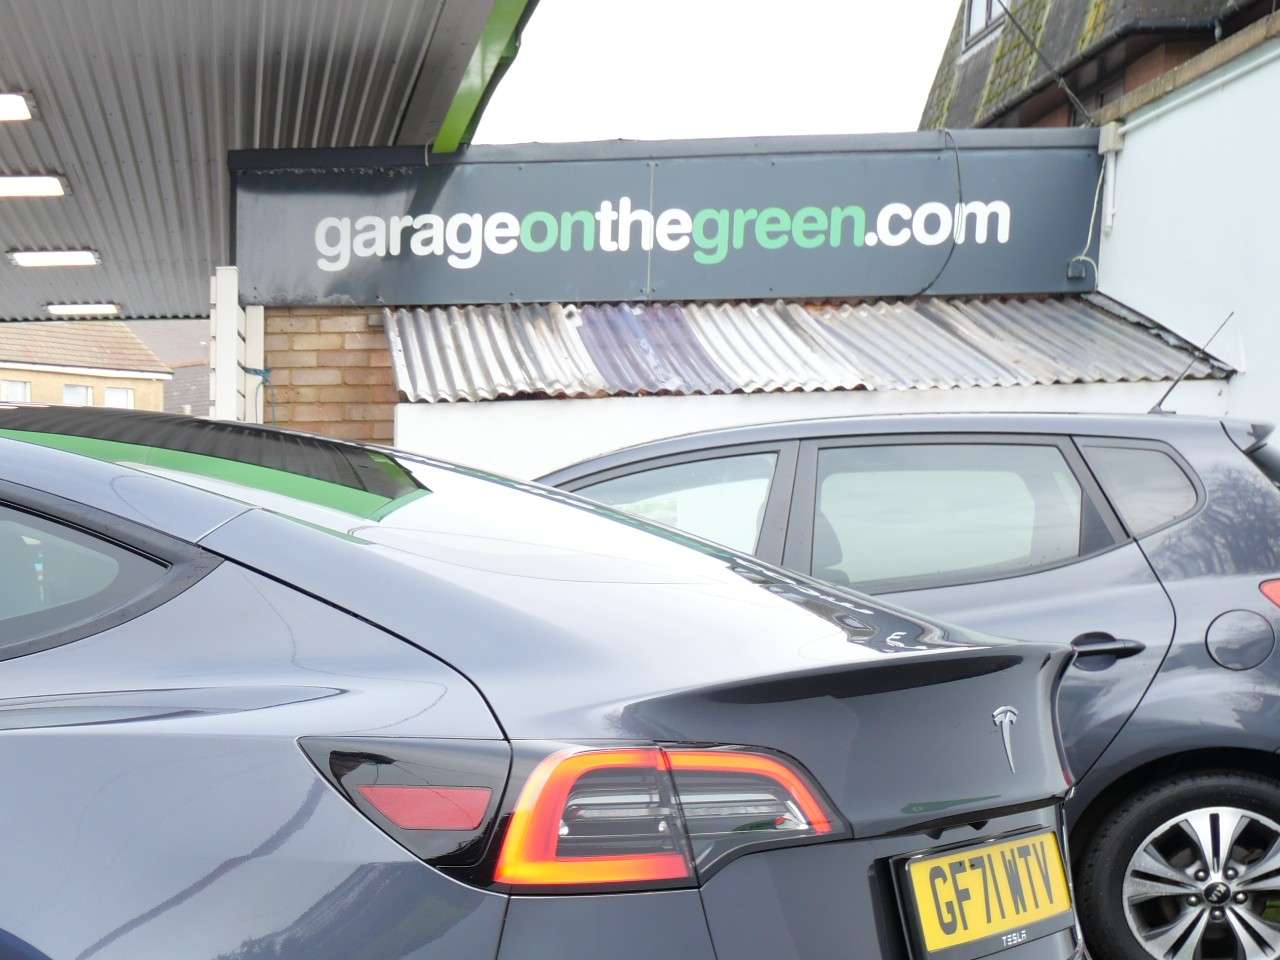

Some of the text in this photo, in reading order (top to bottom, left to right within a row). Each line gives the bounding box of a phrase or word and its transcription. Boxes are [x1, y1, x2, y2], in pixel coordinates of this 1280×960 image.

[314, 197, 1011, 272] garageonthegreen.com
[1000, 841, 1054, 916] WTV
[1001, 930, 1028, 947] TESLA
